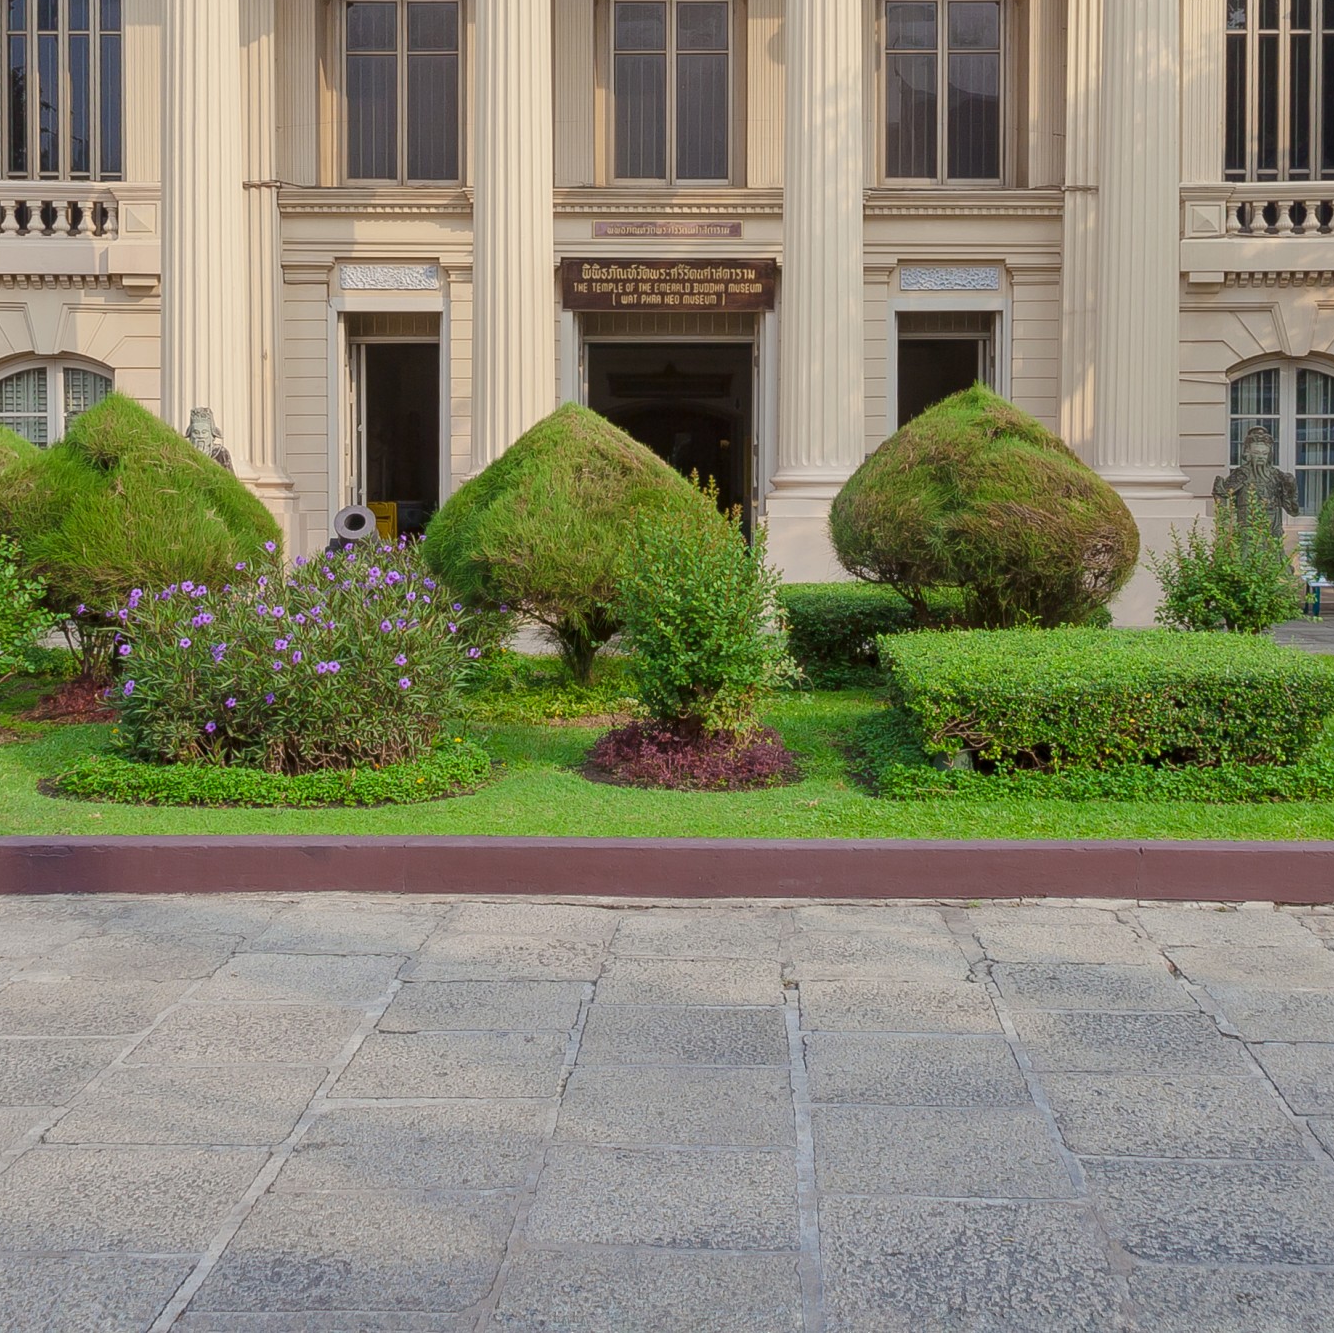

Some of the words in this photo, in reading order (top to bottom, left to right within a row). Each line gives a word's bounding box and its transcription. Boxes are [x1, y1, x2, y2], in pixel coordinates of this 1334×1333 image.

[574, 282, 588, 293] THE
[592, 282, 624, 294] TEMPLE
[626, 282, 636, 294] OF
[638, 282, 652, 293] THE
[654, 282, 691, 293] EMERALD
[693, 282, 725, 294] BUDDHA
[728, 282, 763, 294] MUSEUM
[621, 295, 638, 305] WAT
[641, 295, 662, 305] PHRA
[664, 295, 680, 305] KEO
[682, 295, 717, 305] MUSEUM
